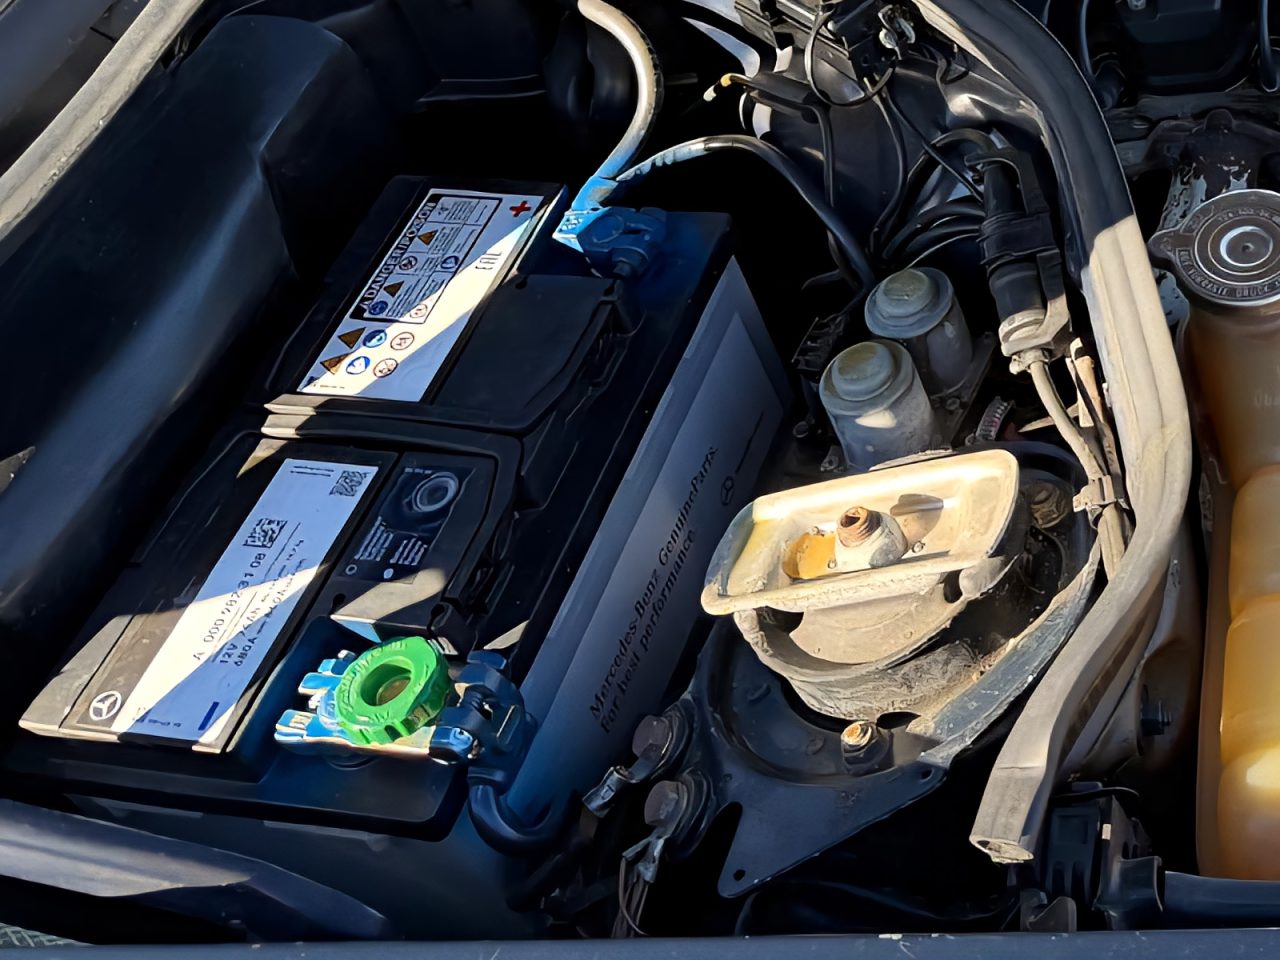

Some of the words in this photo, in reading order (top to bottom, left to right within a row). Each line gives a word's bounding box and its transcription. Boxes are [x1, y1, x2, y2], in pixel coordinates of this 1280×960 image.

[219, 643, 238, 664] 12V
[589, 569, 662, 722] Mercedes-Benz
[601, 692, 621, 734] For
[619, 652, 641, 694] best
[640, 529, 696, 654] performance
